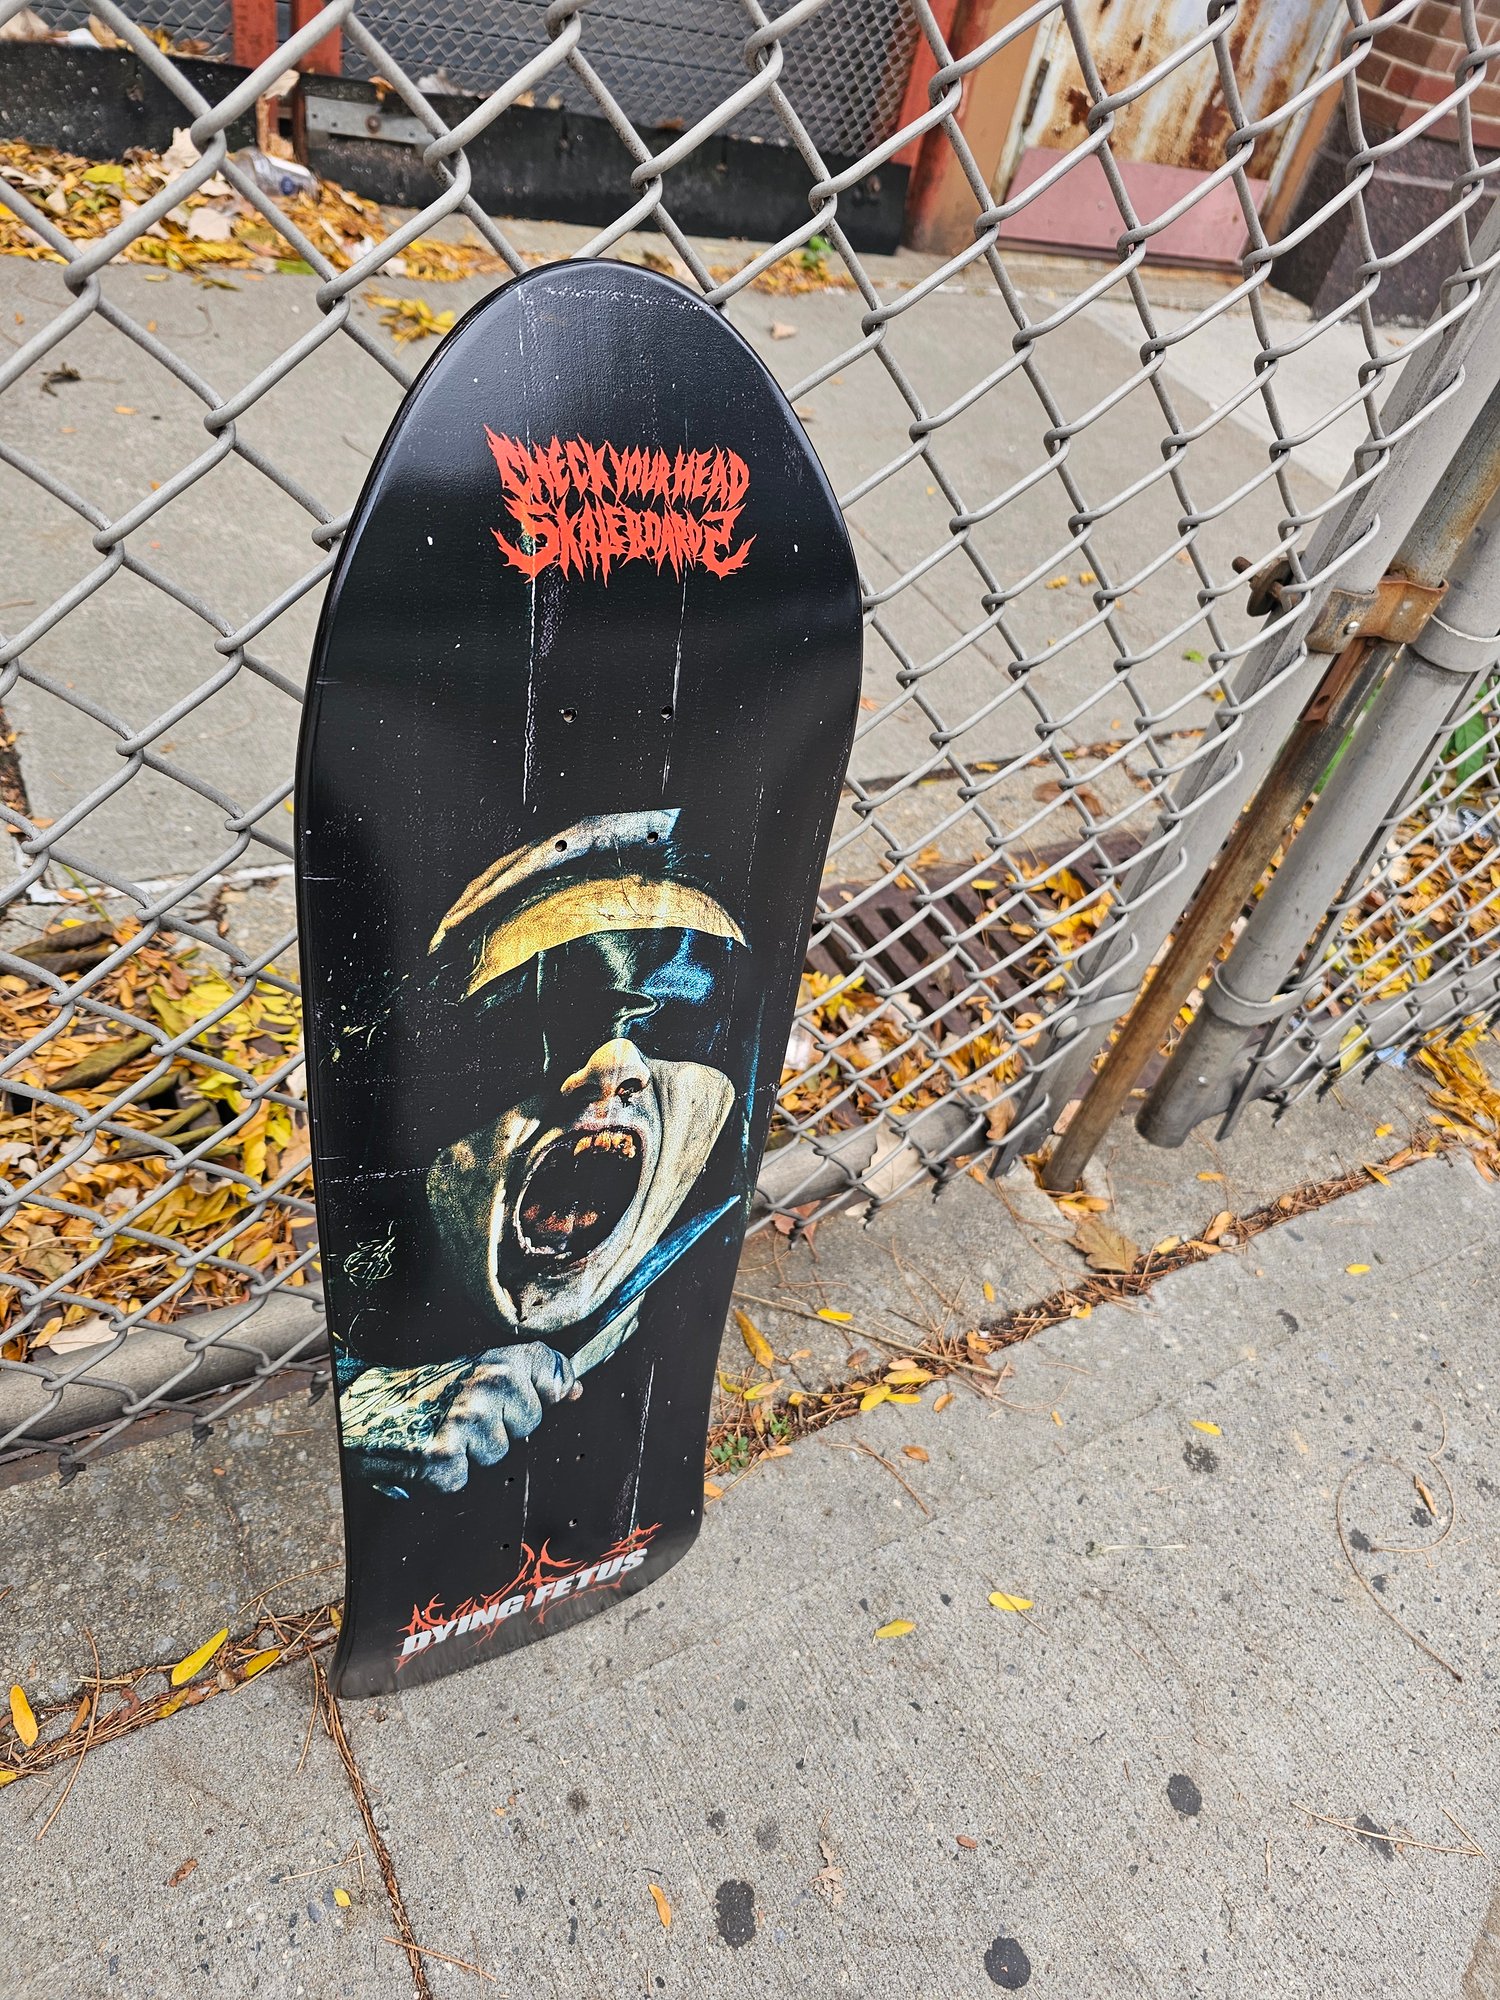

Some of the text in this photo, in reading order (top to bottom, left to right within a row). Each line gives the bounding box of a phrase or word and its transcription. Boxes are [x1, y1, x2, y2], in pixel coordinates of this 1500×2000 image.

[484, 424, 750, 508] CHECK YOUR HEAD
[490, 495, 757, 588] SKATEBOARDS
[401, 1548, 648, 1656] DYING FETUS
